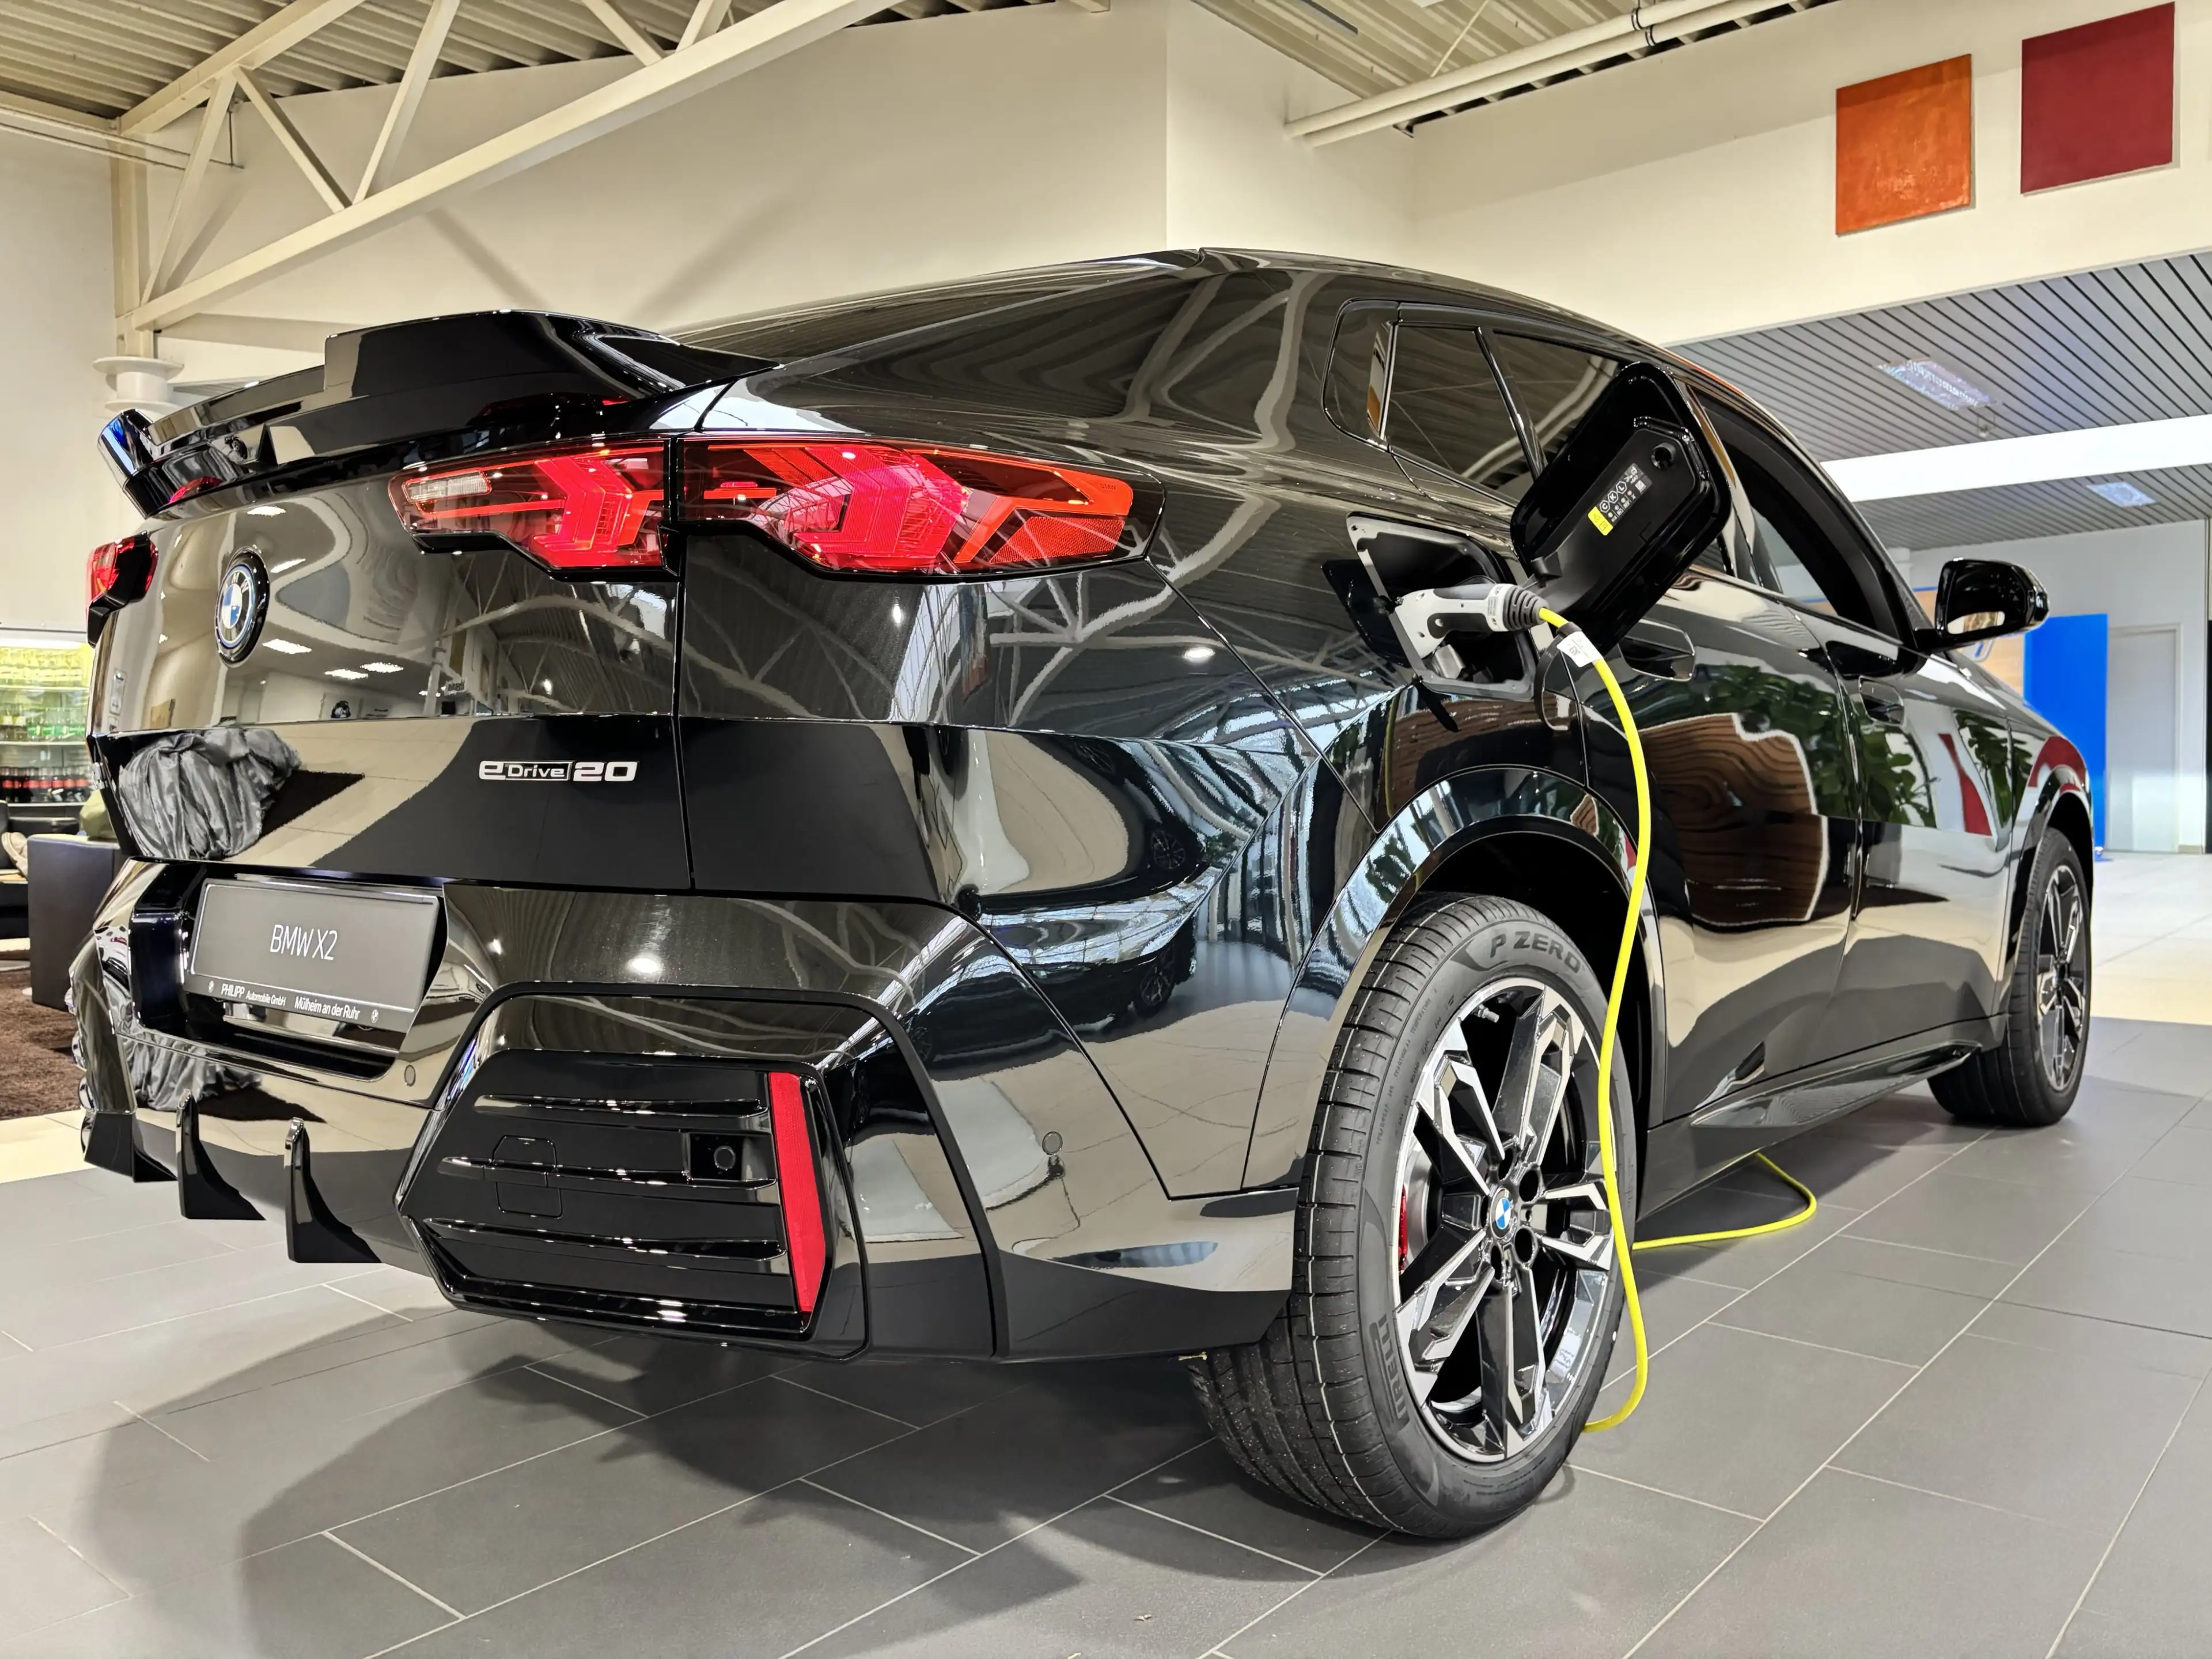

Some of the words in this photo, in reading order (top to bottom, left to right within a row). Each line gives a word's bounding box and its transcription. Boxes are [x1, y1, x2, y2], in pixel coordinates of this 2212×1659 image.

[573, 762, 639, 781] 20
[270, 924, 314, 957] BMW
[312, 929, 339, 961] X2
[1490, 934, 1506, 958] P
[1513, 931, 1581, 974] ZERO
[221, 983, 245, 998] PHILIPP
[246, 990, 270, 1003] Automobile
[271, 995, 287, 1006] GmbH
[294, 996, 321, 1013] Mülheim
[321, 1004, 331, 1014] an
[331, 1003, 344, 1017] der
[343, 1005, 361, 1020] Ruhr
